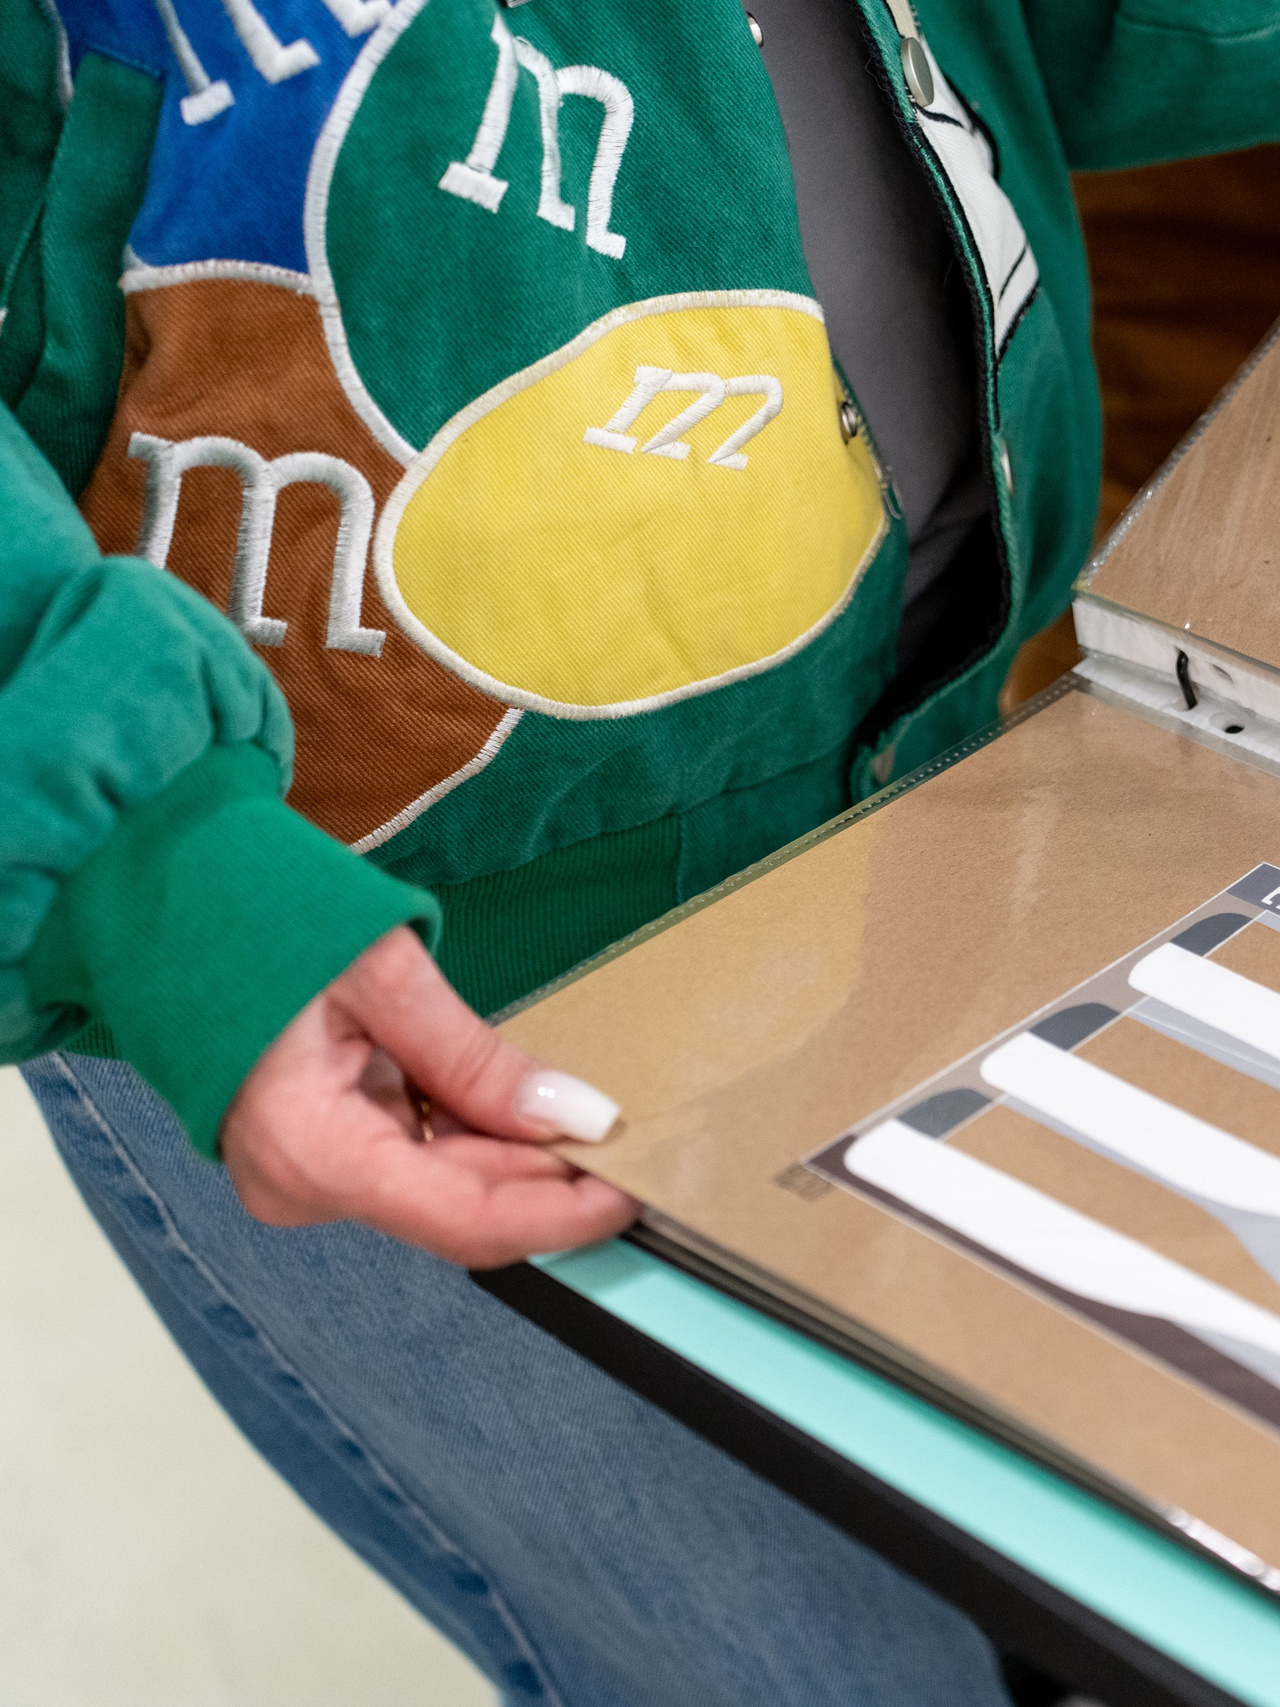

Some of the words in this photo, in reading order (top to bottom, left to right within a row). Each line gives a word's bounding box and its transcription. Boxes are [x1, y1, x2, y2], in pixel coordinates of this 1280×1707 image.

[437, 12, 635, 260] m
[583, 365, 784, 470] m
[127, 432, 387, 658] m
